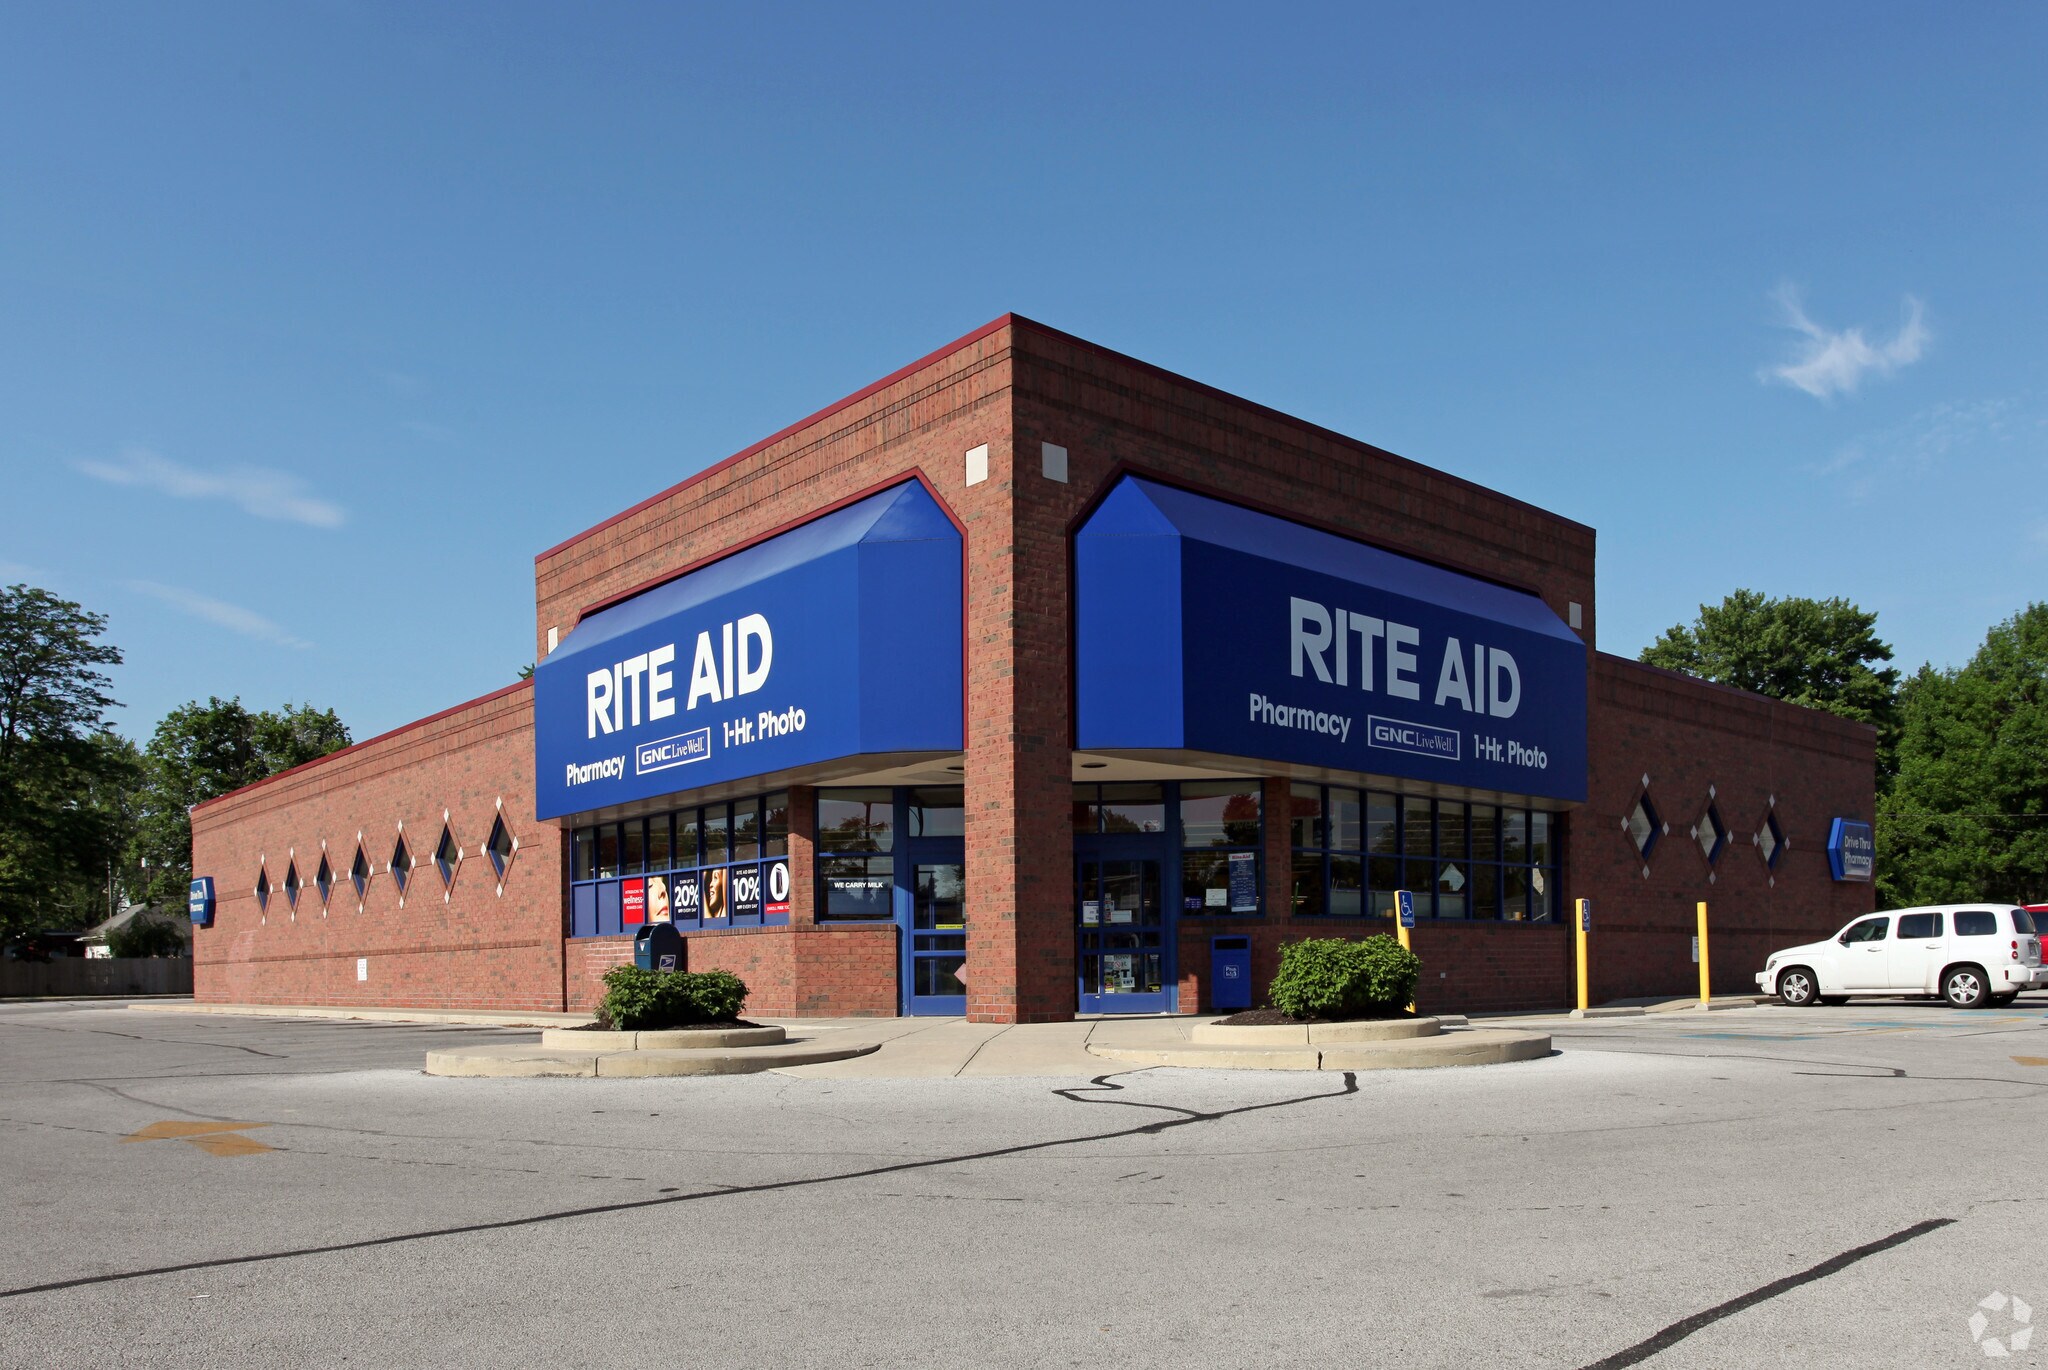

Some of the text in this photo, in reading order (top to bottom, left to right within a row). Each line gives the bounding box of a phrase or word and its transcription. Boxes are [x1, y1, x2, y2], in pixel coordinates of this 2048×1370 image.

[1290, 597, 1521, 719] RITE AID
[587, 613, 773, 739] RITE AID
[723, 706, 806, 748] 1-Hr. Photo
[1250, 694, 1351, 743] Pharmacy
[1375, 725, 1414, 745] GNC
[641, 745, 671, 765] GNC
[1474, 734, 1548, 769] 1-Hr. Photo
[566, 755, 626, 787] Pharmacy
[1844, 836, 1871, 850] Drive Thru
[1844, 852, 1872, 868] Pharmacy
[674, 884, 699, 907] 20%
[733, 876, 759, 902] 10%
